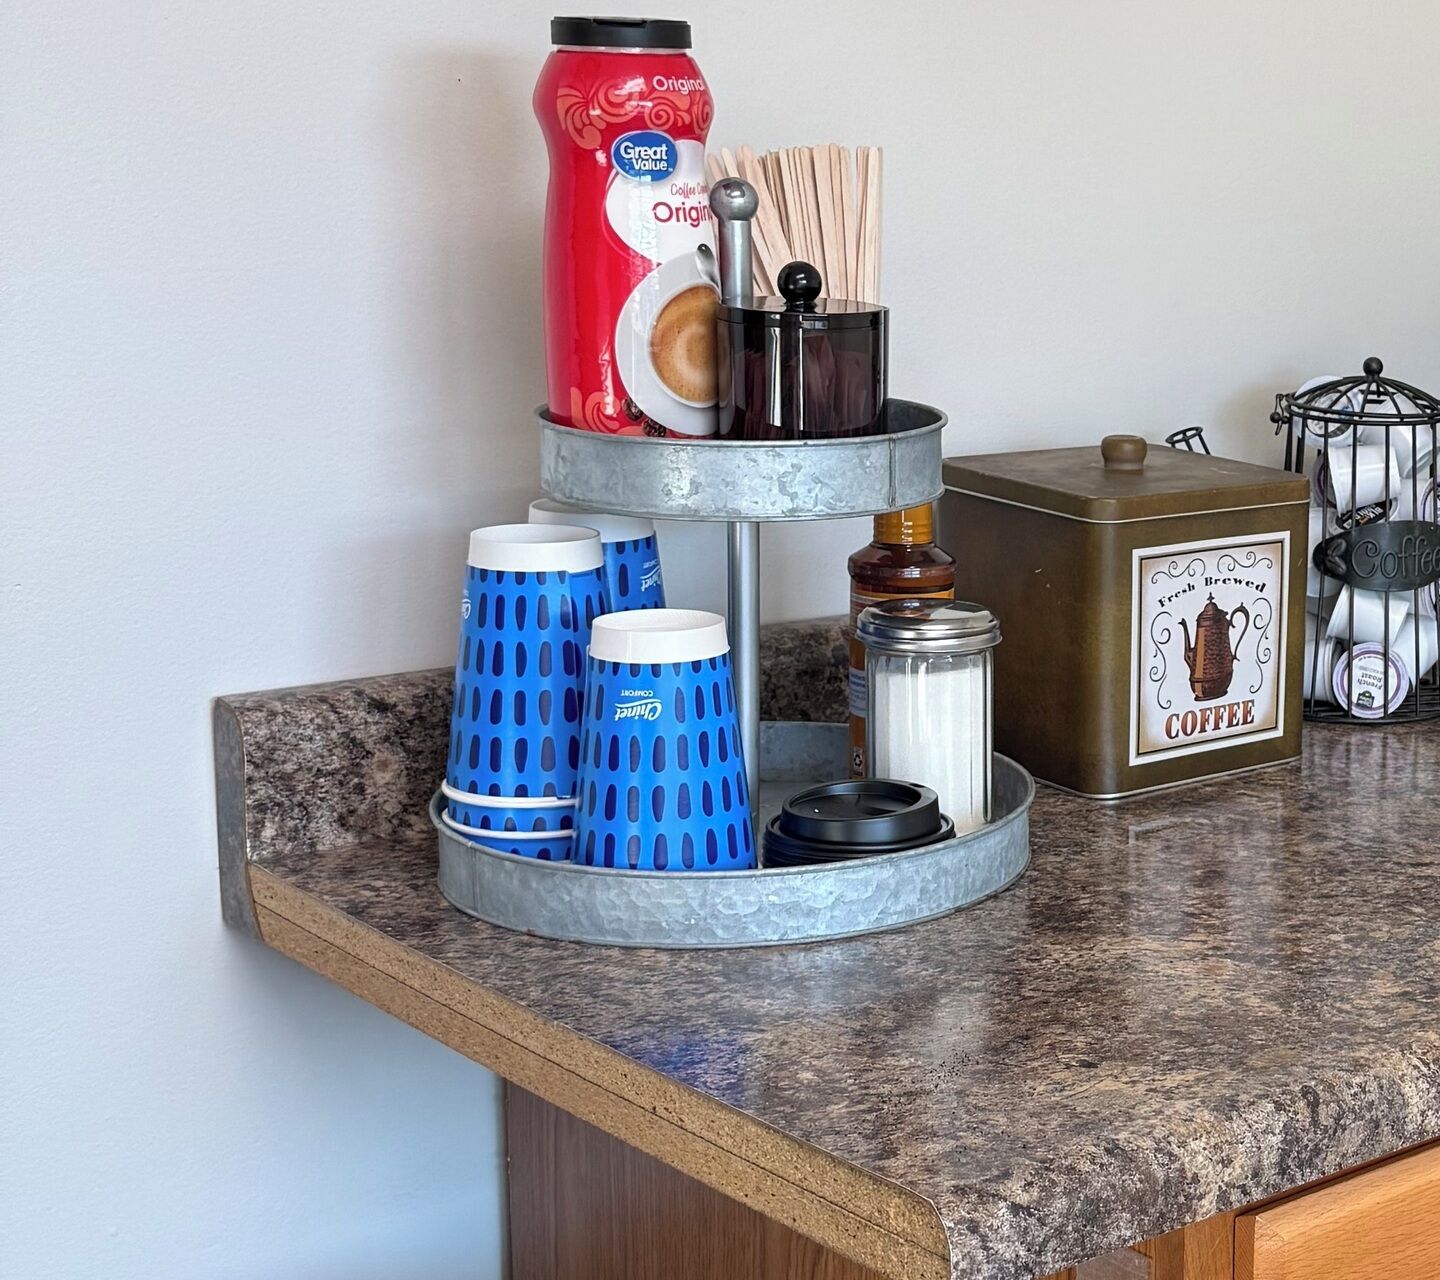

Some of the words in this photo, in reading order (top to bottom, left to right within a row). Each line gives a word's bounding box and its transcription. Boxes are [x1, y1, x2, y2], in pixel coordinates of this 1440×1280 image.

[652, 75, 705, 96] Origina
[619, 141, 669, 161] Great
[632, 158, 668, 171] Value
[670, 182, 696, 199] Coffee
[652, 201, 712, 228] Origin
[1157, 582, 1196, 608] Fresh
[1204, 575, 1267, 594] Brewed
[1357, 677, 1384, 691] French
[1361, 672, 1383, 683] Roast
[620, 689, 654, 698] COMFORT
[614, 700, 663, 721] Chinet
[1164, 698, 1256, 740] COFFEE
